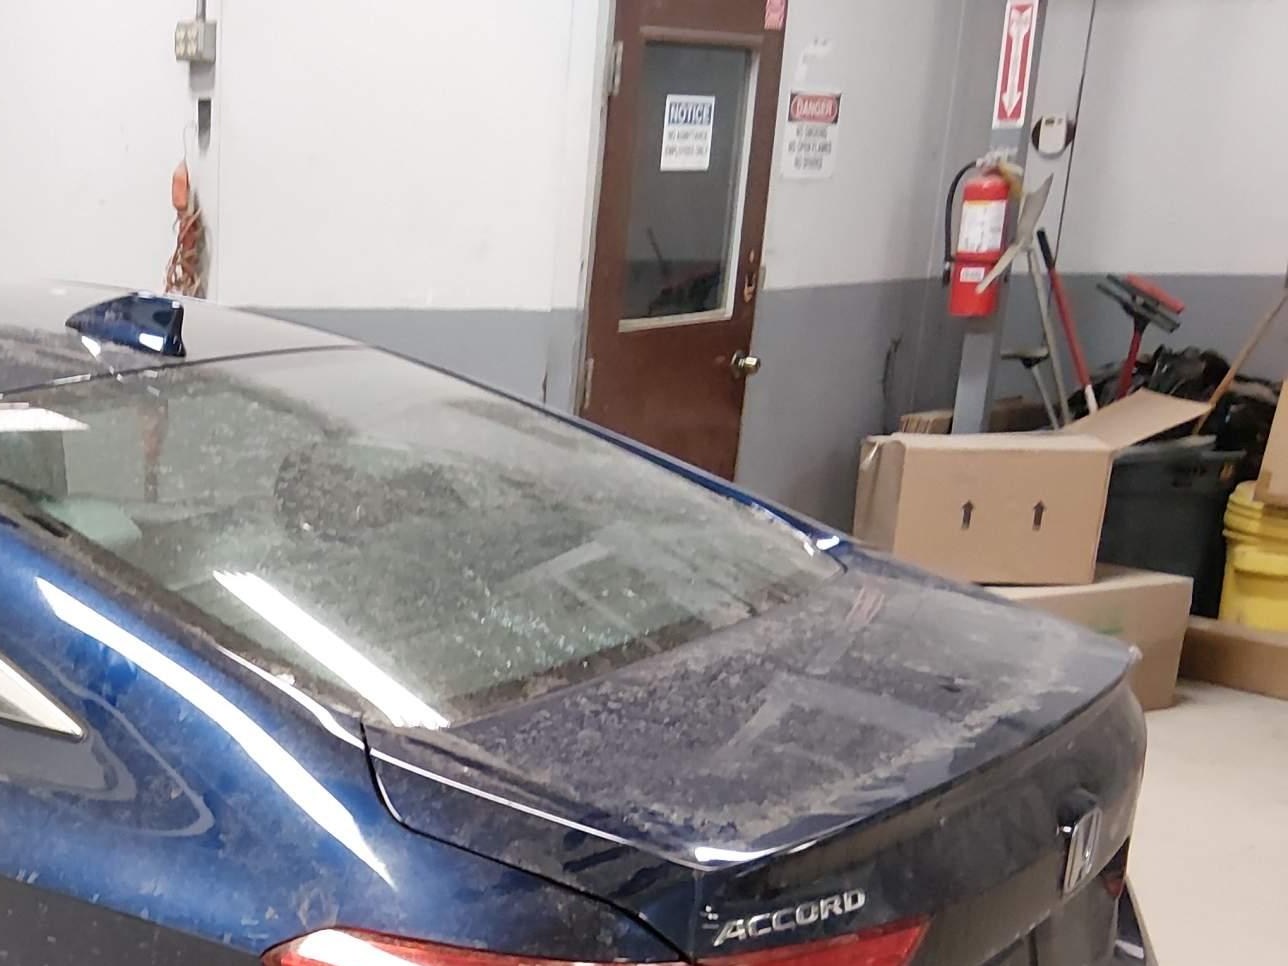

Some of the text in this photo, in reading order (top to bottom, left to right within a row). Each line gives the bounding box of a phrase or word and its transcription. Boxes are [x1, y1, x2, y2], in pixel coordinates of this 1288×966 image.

[669, 103, 712, 125] NOTICE
[795, 97, 833, 117] DANGER
[713, 888, 866, 947] ACCORD
